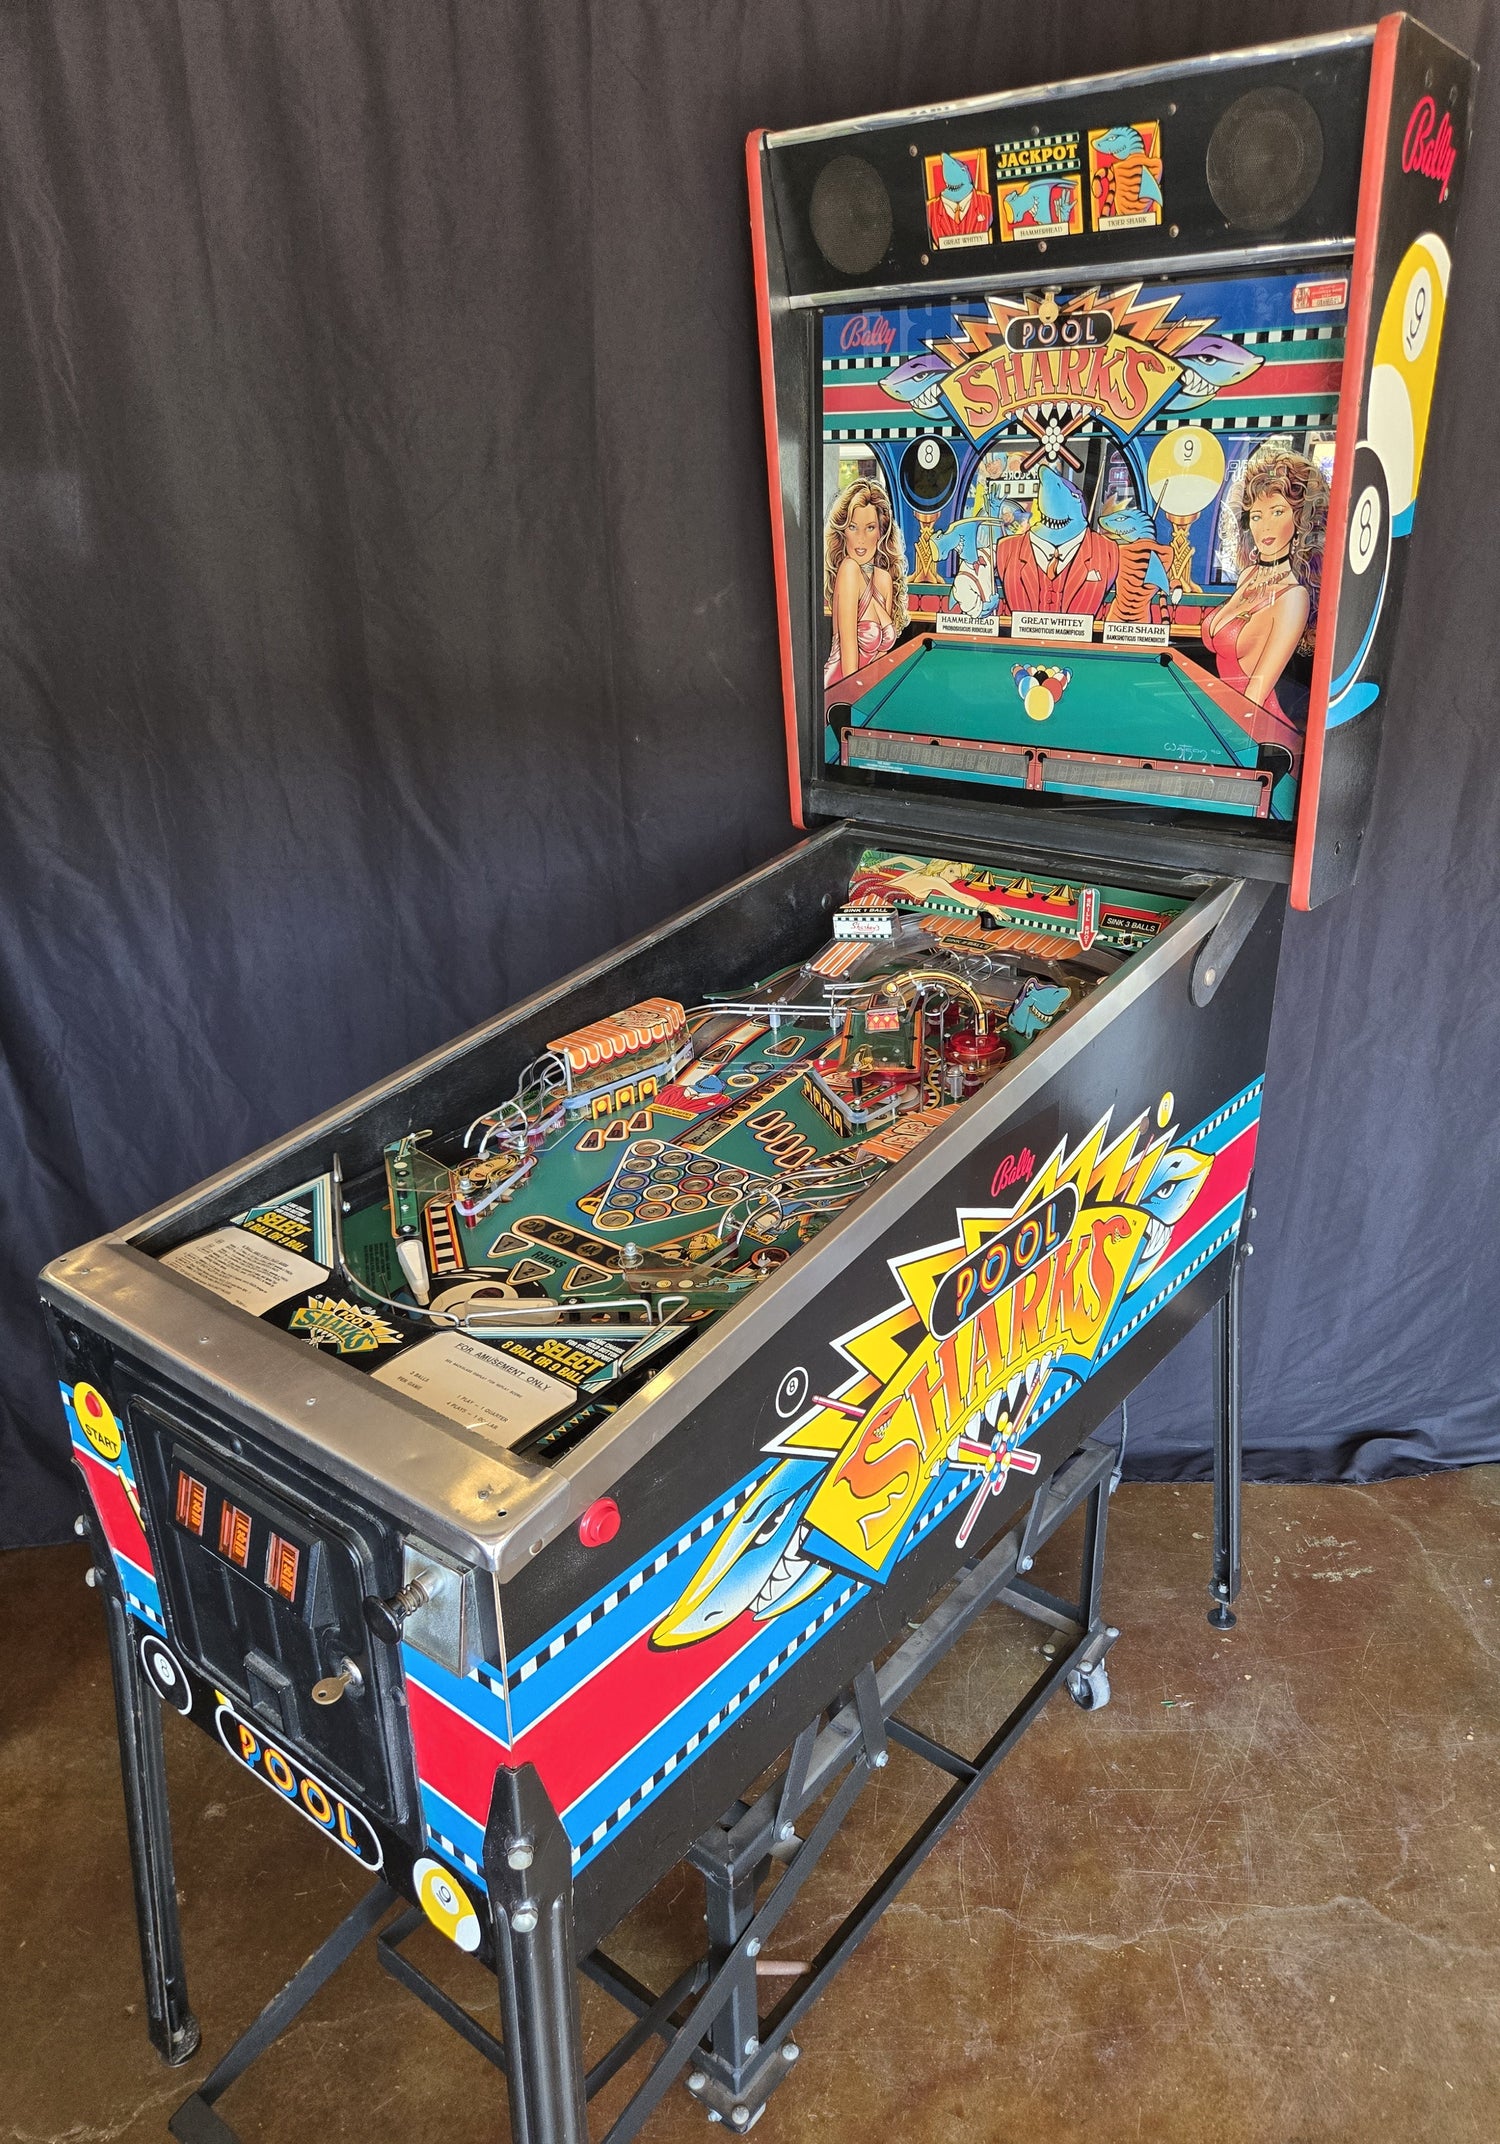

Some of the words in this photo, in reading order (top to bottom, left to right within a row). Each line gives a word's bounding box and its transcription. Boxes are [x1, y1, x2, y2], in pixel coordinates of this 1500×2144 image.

[997, 144, 1079, 169] JACKPOT
[1402, 95, 1457, 204] Bally
[1020, 226, 1064, 238] HAMMERHEAD
[1108, 217, 1126, 226] TIGER
[1126, 215, 1148, 225] SHARK
[943, 238, 961, 247] GREAT
[840, 315, 897, 354] Bally
[1022, 318, 1097, 349] POOL
[955, 346, 1166, 427] SHARKS
[924, 442, 934, 465] 8
[1183, 440, 1194, 464] 9
[1359, 500, 1372, 557] 8
[941, 616, 994, 626] HAMMERHEAD
[1021, 616, 1050, 625] GREAT
[1051, 618, 1084, 628] WHITEY
[1108, 624, 1134, 633] TIGER
[1135, 626, 1166, 635] SHARK
[1107, 918, 1124, 927] SINK
[1125, 920, 1130, 928] 3
[1131, 922, 1156, 932] BALLS
[990, 1147, 1036, 1198] Bally
[256, 1212, 312, 1238] SELECT
[522, 1221, 542, 1231] 2X
[552, 1232, 571, 1243] 3X
[249, 1223, 272, 1236] BALL
[284, 1239, 308, 1253] BALL
[582, 1245, 599, 1256] 4X
[523, 1268, 535, 1276] 2
[531, 1250, 567, 1269] RACKS
[956, 1202, 1060, 1321] POOL
[581, 1273, 592, 1281] 3
[294, 1309, 375, 1350] SHARKS
[338, 1310, 369, 1329] POOL
[535, 1339, 606, 1374] SELECT
[565, 1339, 578, 1347] FOR
[575, 1343, 595, 1355] STATUS
[456, 1342, 474, 1354] FOR
[475, 1351, 525, 1378] AMUSEMENT
[526, 1376, 551, 1391] ONLY
[501, 1341, 514, 1349] 8
[509, 1344, 537, 1361] BALL
[534, 1356, 553, 1368] OR
[548, 1363, 561, 1372] 9
[556, 1367, 585, 1384] BALL
[413, 1373, 430, 1383] BALLS
[833, 1212, 1132, 1550] SHARKS
[452, 1403, 466, 1415] PLAYS
[477, 1417, 498, 1430] DOLAR
[460, 1396, 474, 1405] PLAY
[484, 1408, 509, 1423] QUARTER
[85, 1423, 118, 1454] START
[238, 1724, 362, 1856] POOL
